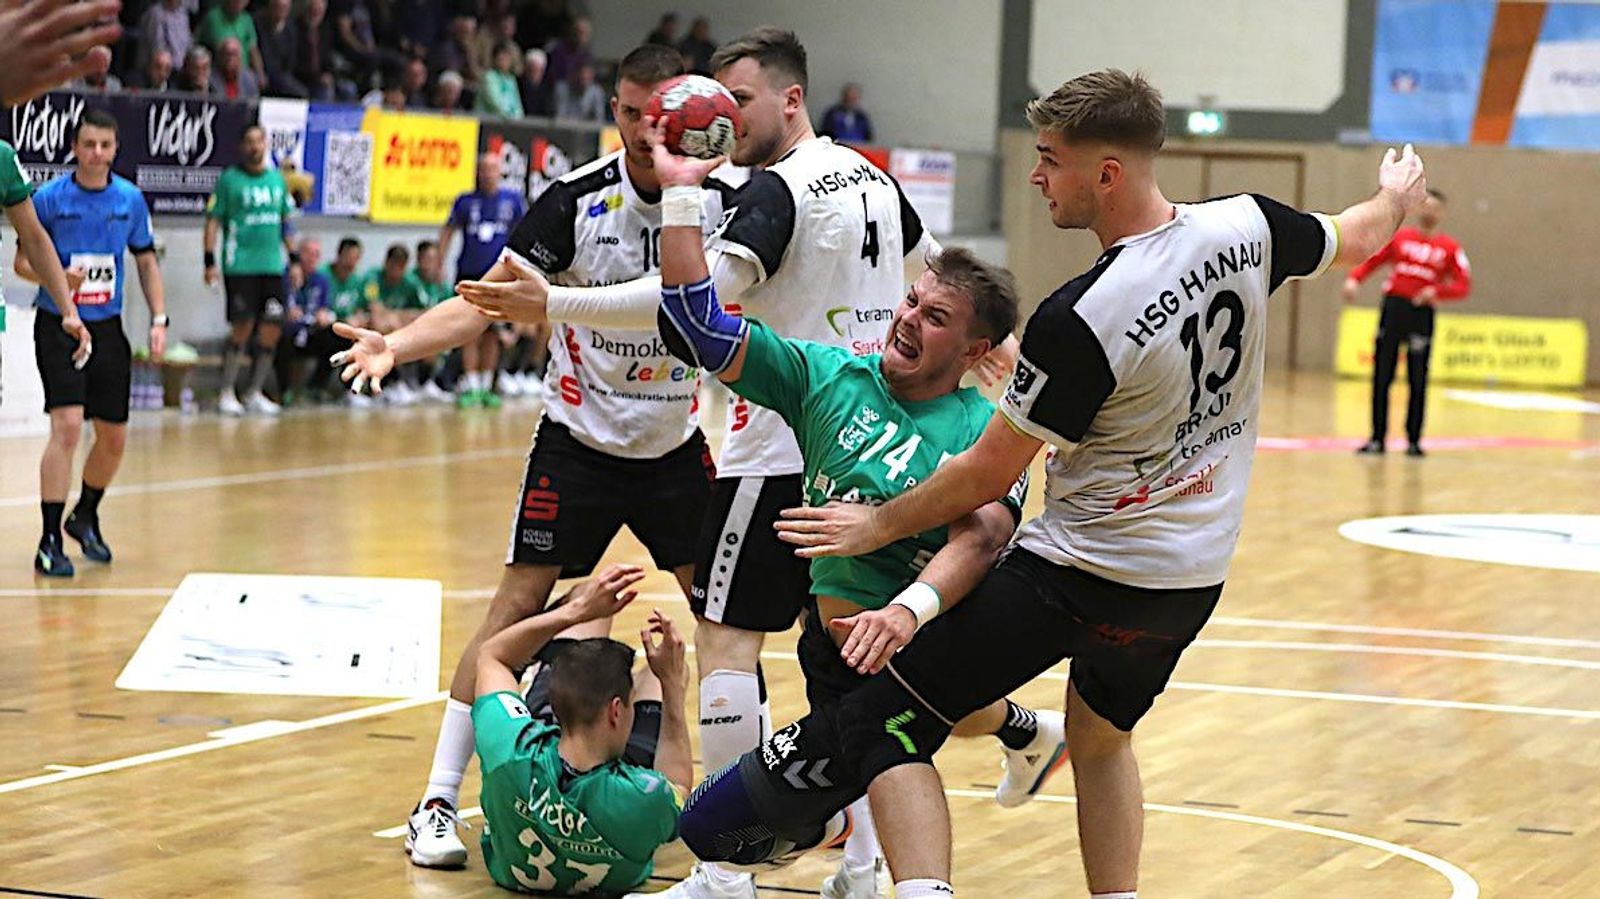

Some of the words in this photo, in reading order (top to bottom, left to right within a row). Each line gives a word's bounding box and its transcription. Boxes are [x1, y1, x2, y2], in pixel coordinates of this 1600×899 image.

[408, 137, 463, 171] LOTTO
[807, 171, 848, 199] HSG
[595, 236, 620, 246] JAKO
[1125, 289, 1181, 349] HSG
[1178, 241, 1263, 301] HANAU
[589, 329, 670, 358] Demok
[1180, 289, 1246, 414] 13
[858, 420, 923, 482] 14
[510, 826, 612, 891] 37
